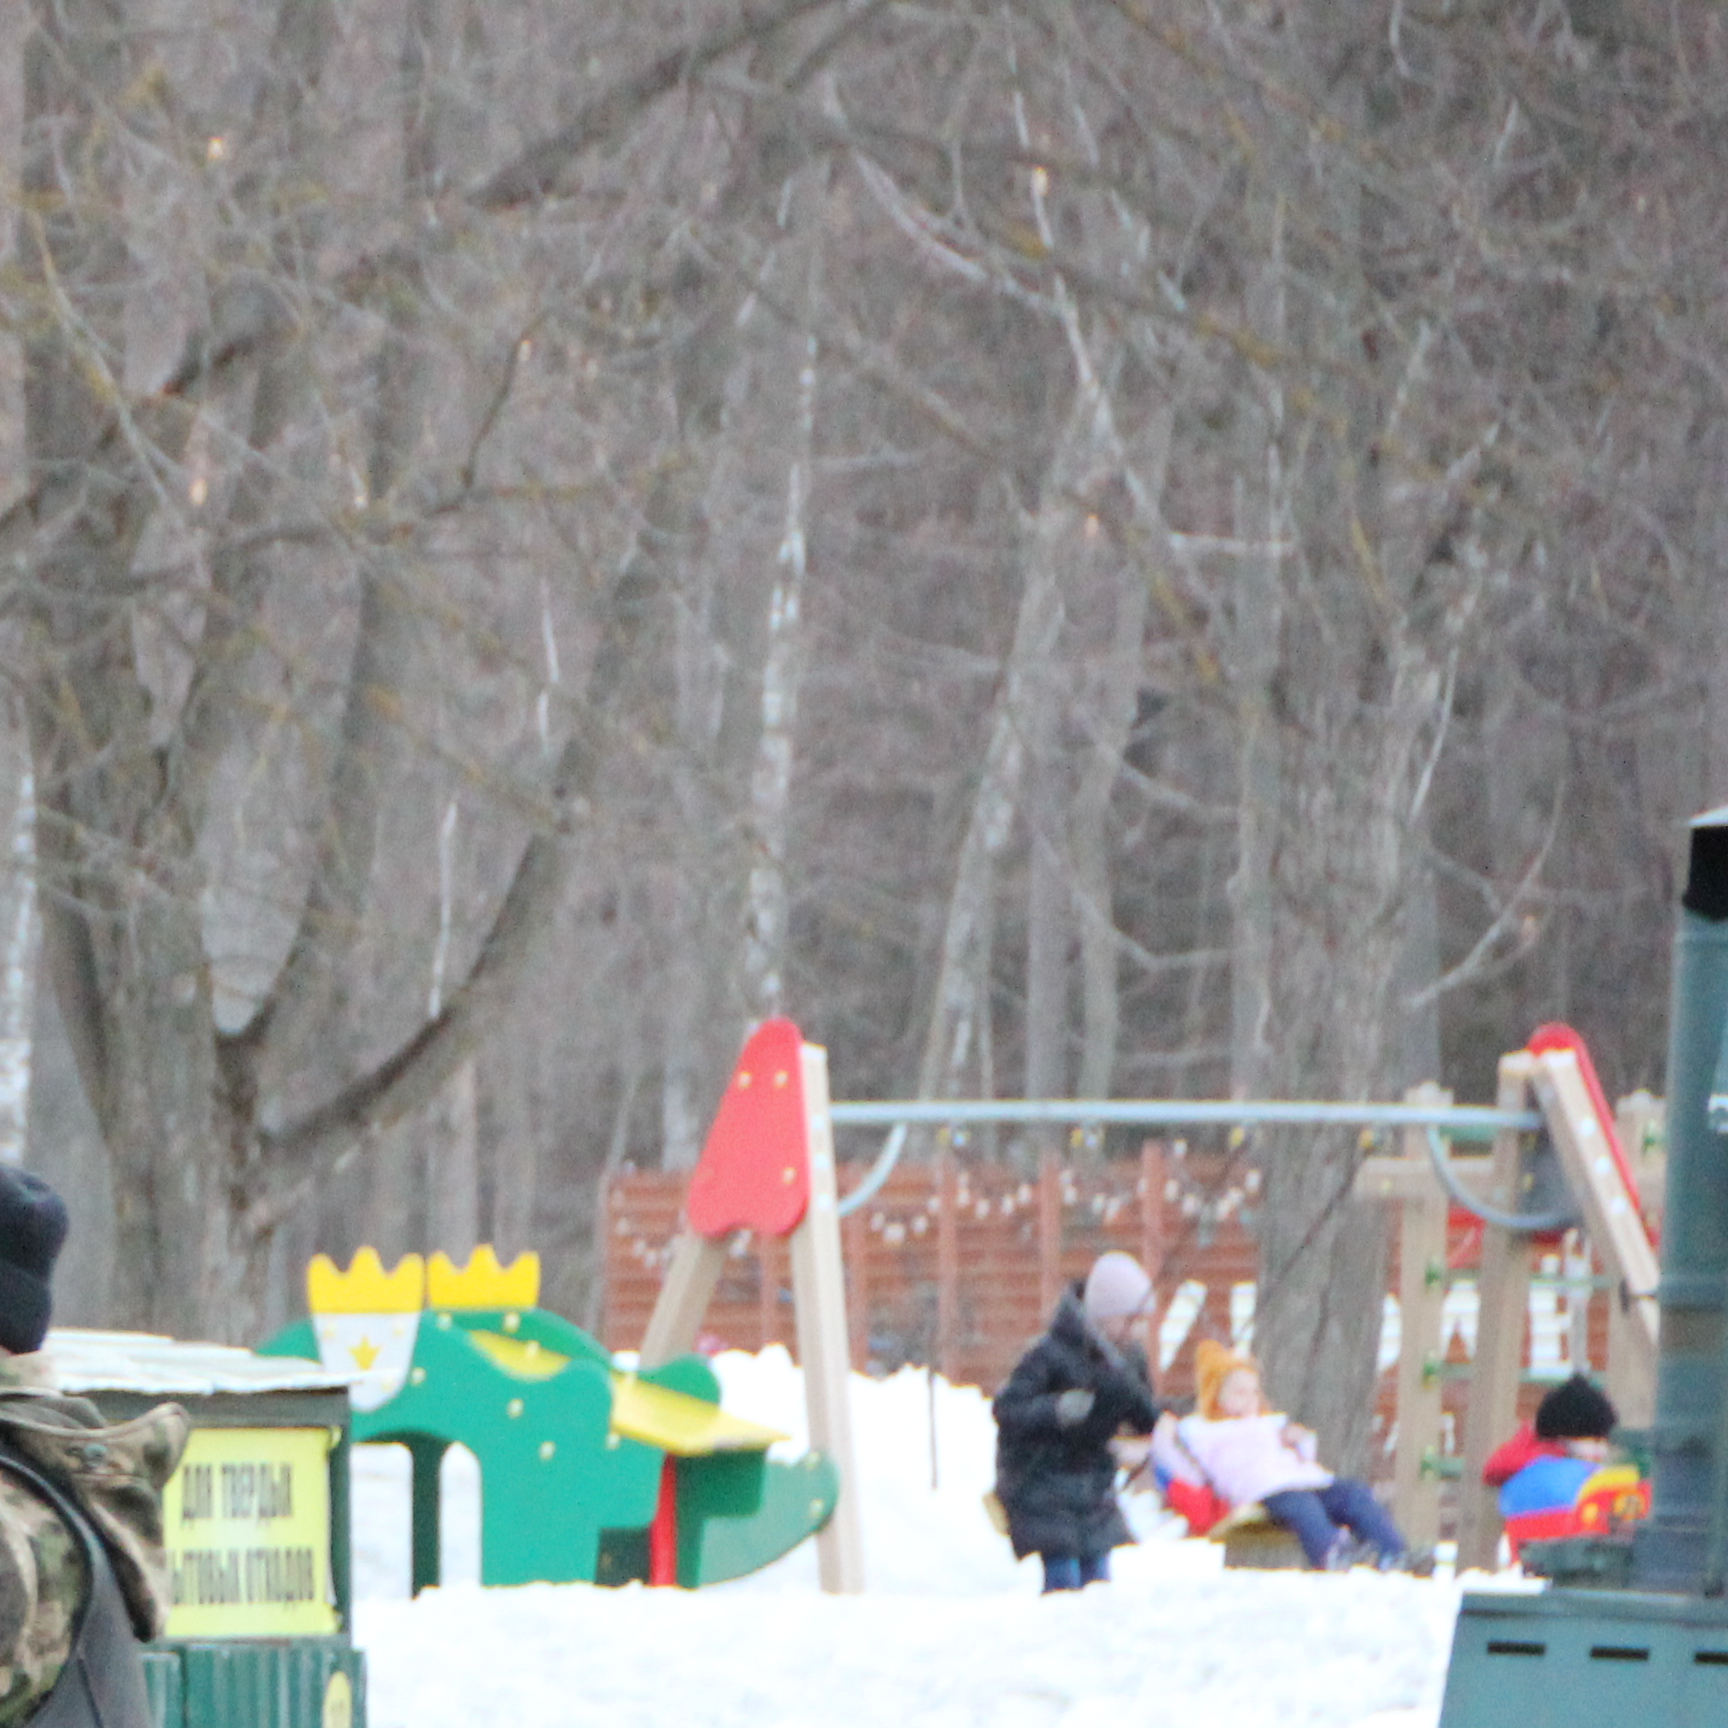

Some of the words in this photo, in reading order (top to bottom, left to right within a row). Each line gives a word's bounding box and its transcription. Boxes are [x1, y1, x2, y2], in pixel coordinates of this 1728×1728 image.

[181, 1464, 213, 1524] ДЛЯ
[167, 1549, 240, 1604] ЫТОВЫХ
[245, 1547, 315, 1609] ОТХОДОВ
